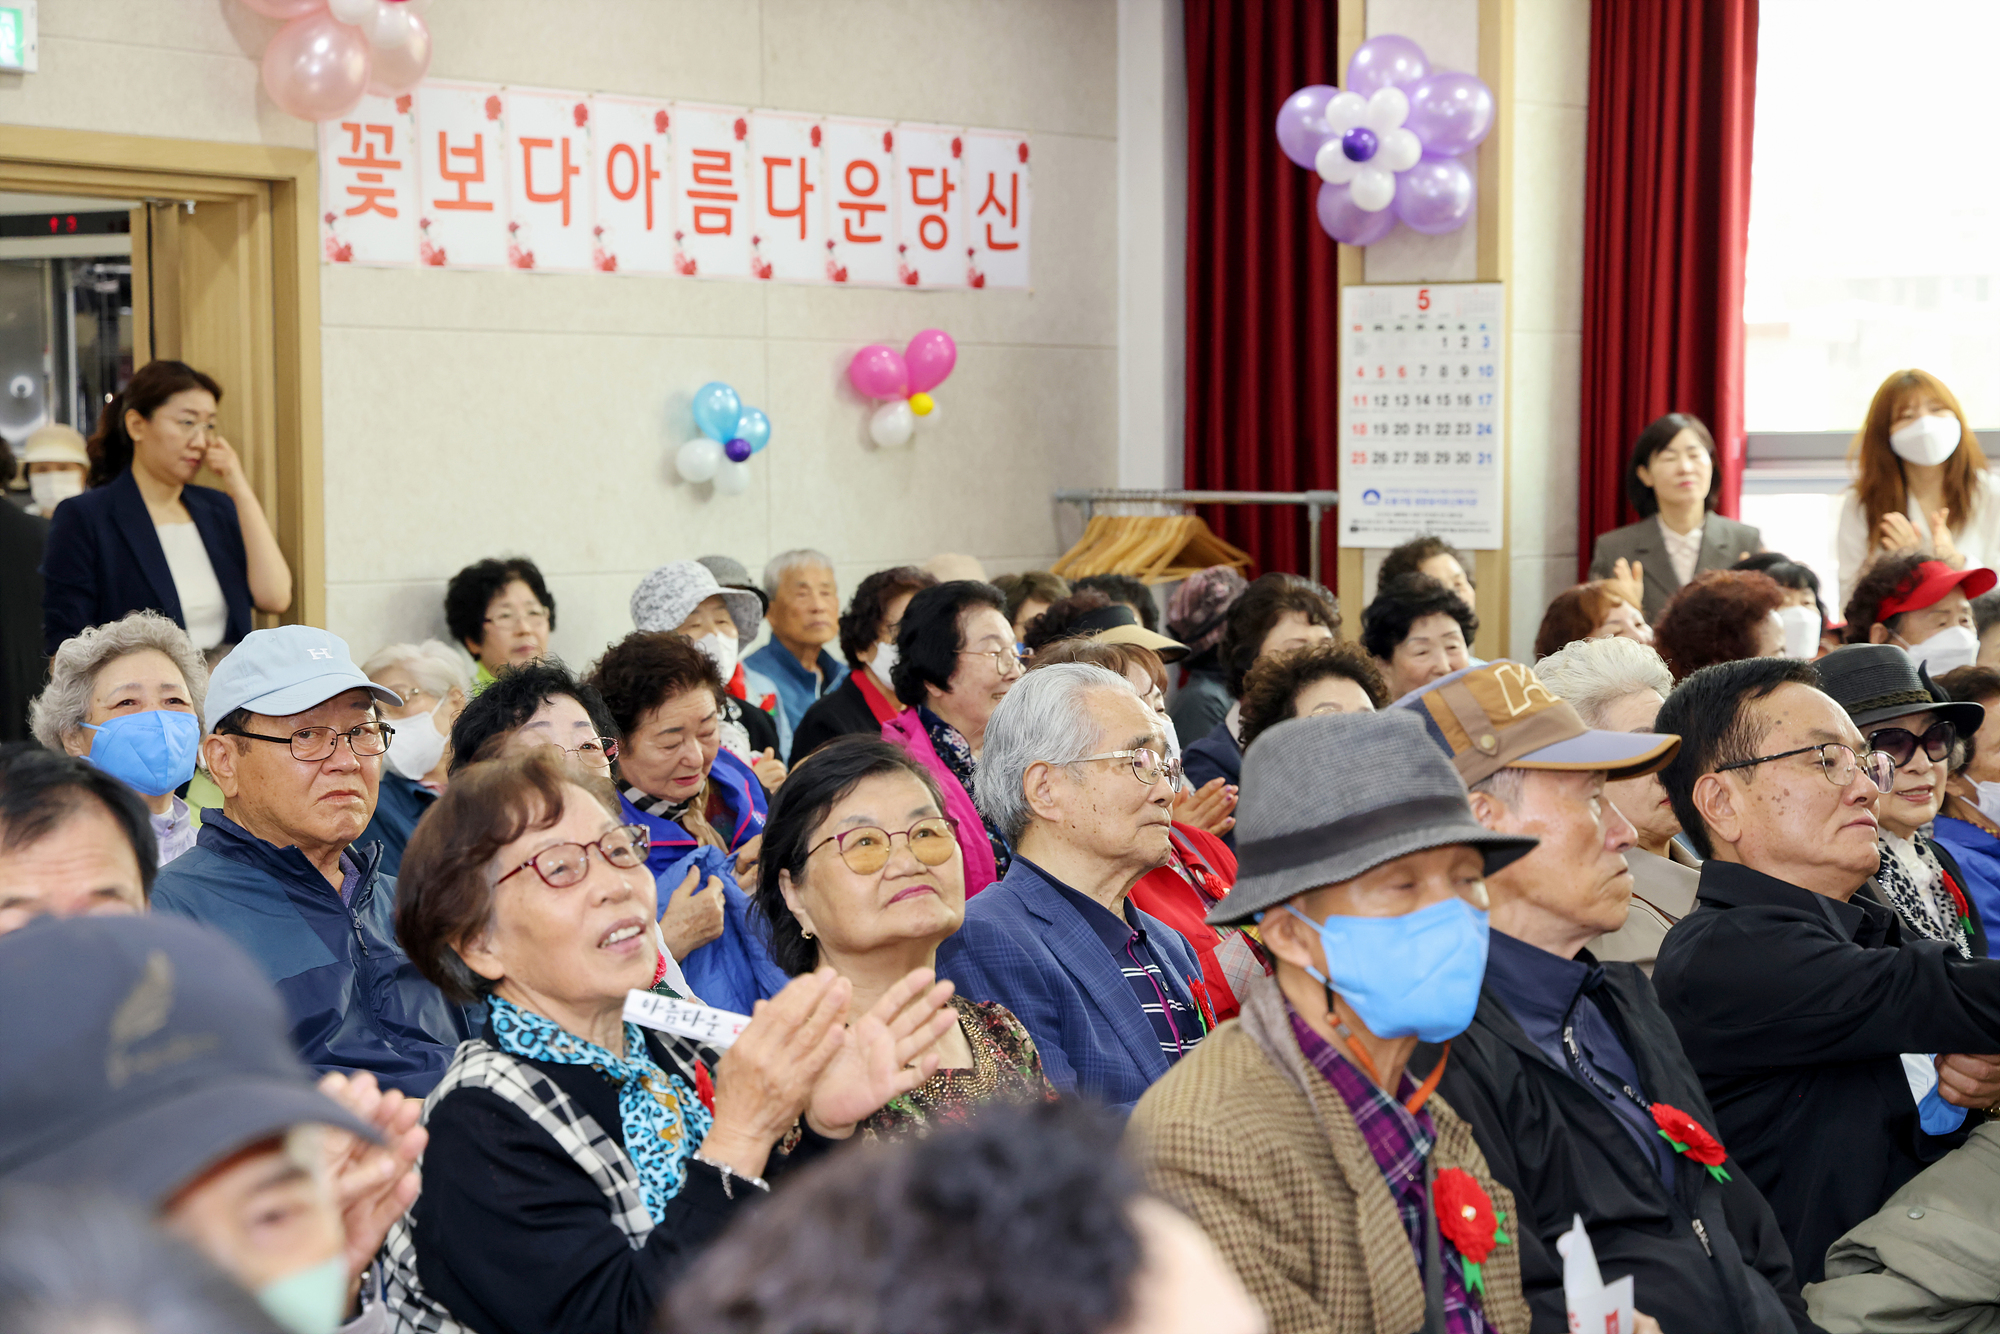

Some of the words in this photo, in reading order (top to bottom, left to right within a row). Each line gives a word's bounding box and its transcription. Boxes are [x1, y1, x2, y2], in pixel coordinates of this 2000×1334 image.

[1417, 289, 1431, 311] 5
[1442, 336, 1448, 348] 1
[1461, 336, 1469, 349] 2
[1419, 365, 1427, 378] 7
[1439, 365, 1449, 378] 8
[1460, 365, 1469, 378] 9
[1478, 364, 1494, 378] 10
[1353, 395, 1368, 407] 11
[1374, 395, 1388, 407] 12
[1395, 395, 1410, 407] 13
[1416, 395, 1430, 406] 14
[1436, 394, 1451, 407] 15
[1457, 394, 1472, 407] 16
[1478, 393, 1493, 406] 17
[1373, 423, 1388, 436] 19
[1394, 423, 1409, 436] 20
[1415, 423, 1430, 436] 21
[1435, 423, 1451, 436] 22
[1456, 423, 1471, 436] 23
[1477, 423, 1493, 436] 24
[1351, 452, 1367, 465] 25
[1372, 452, 1388, 465] 26
[1393, 452, 1409, 465] 27
[1414, 452, 1430, 465] 28
[1435, 452, 1451, 465] 29
[1456, 452, 1471, 465] 30
[1477, 452, 1492, 465] 31
[306, 647, 334, 661] H
